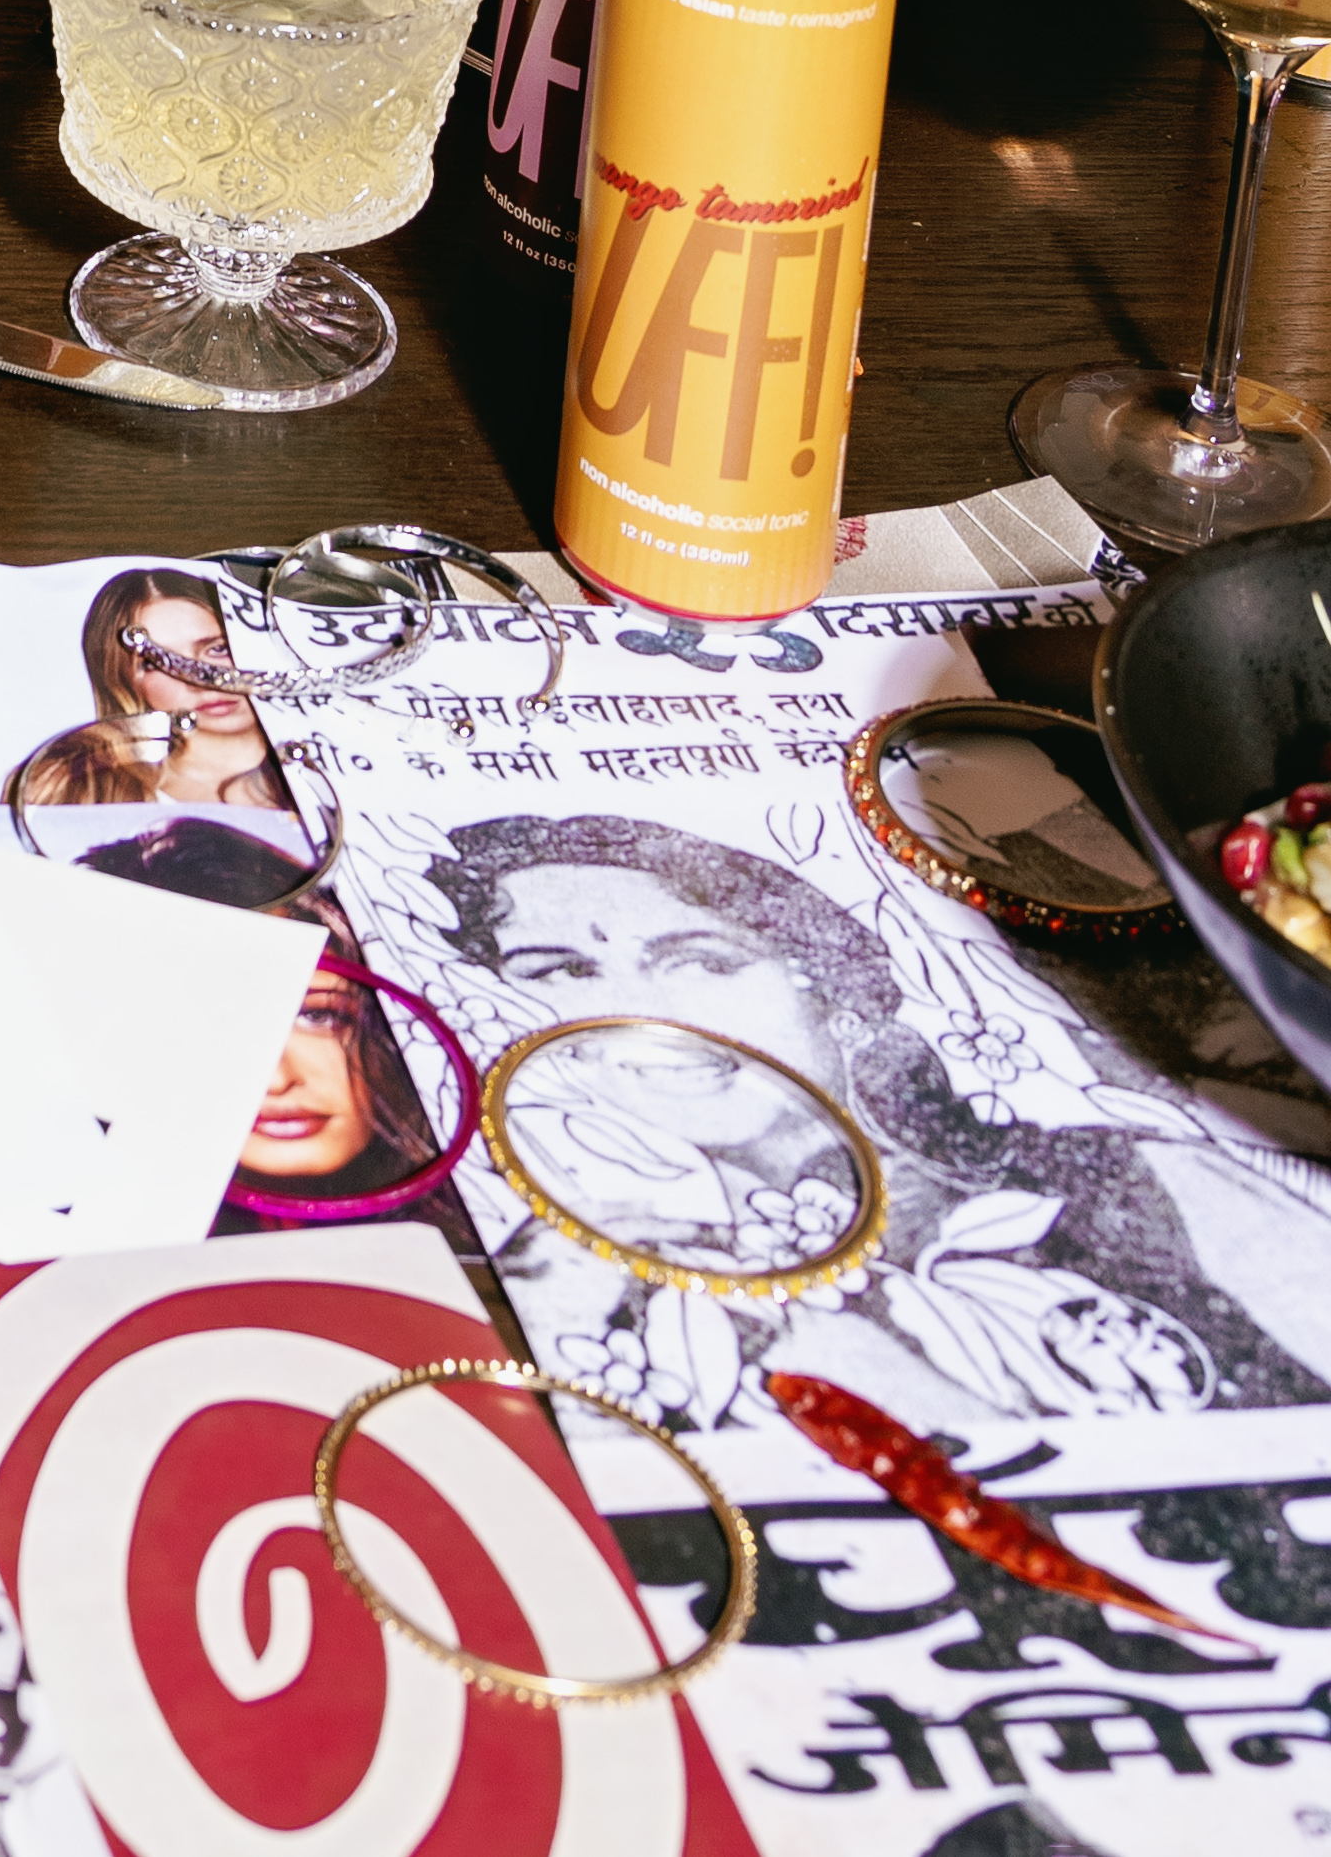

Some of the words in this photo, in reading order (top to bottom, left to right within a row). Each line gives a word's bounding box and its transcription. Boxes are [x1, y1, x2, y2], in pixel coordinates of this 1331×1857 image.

[737, 5, 788, 29] taste
[788, 0, 877, 30] reimagined
[694, 155, 870, 225] tamarind
[497, 191, 562, 238] alcoholic
[502, 230, 513, 245] 12
[515, 237, 524, 252] fl
[525, 247, 540, 260] oz
[543, 252, 577, 273] (350
[577, 199, 845, 482] UFF!
[579, 456, 609, 490] non
[609, 477, 707, 529] alcoholic
[707, 512, 768, 534] social
[767, 507, 811, 533] tonic
[619, 521, 639, 540] 12
[640, 526, 655, 547] fl
[655, 535, 678, 554] oz
[679, 539, 752, 568] (350ml)
[768, 691, 856, 721] तथा
